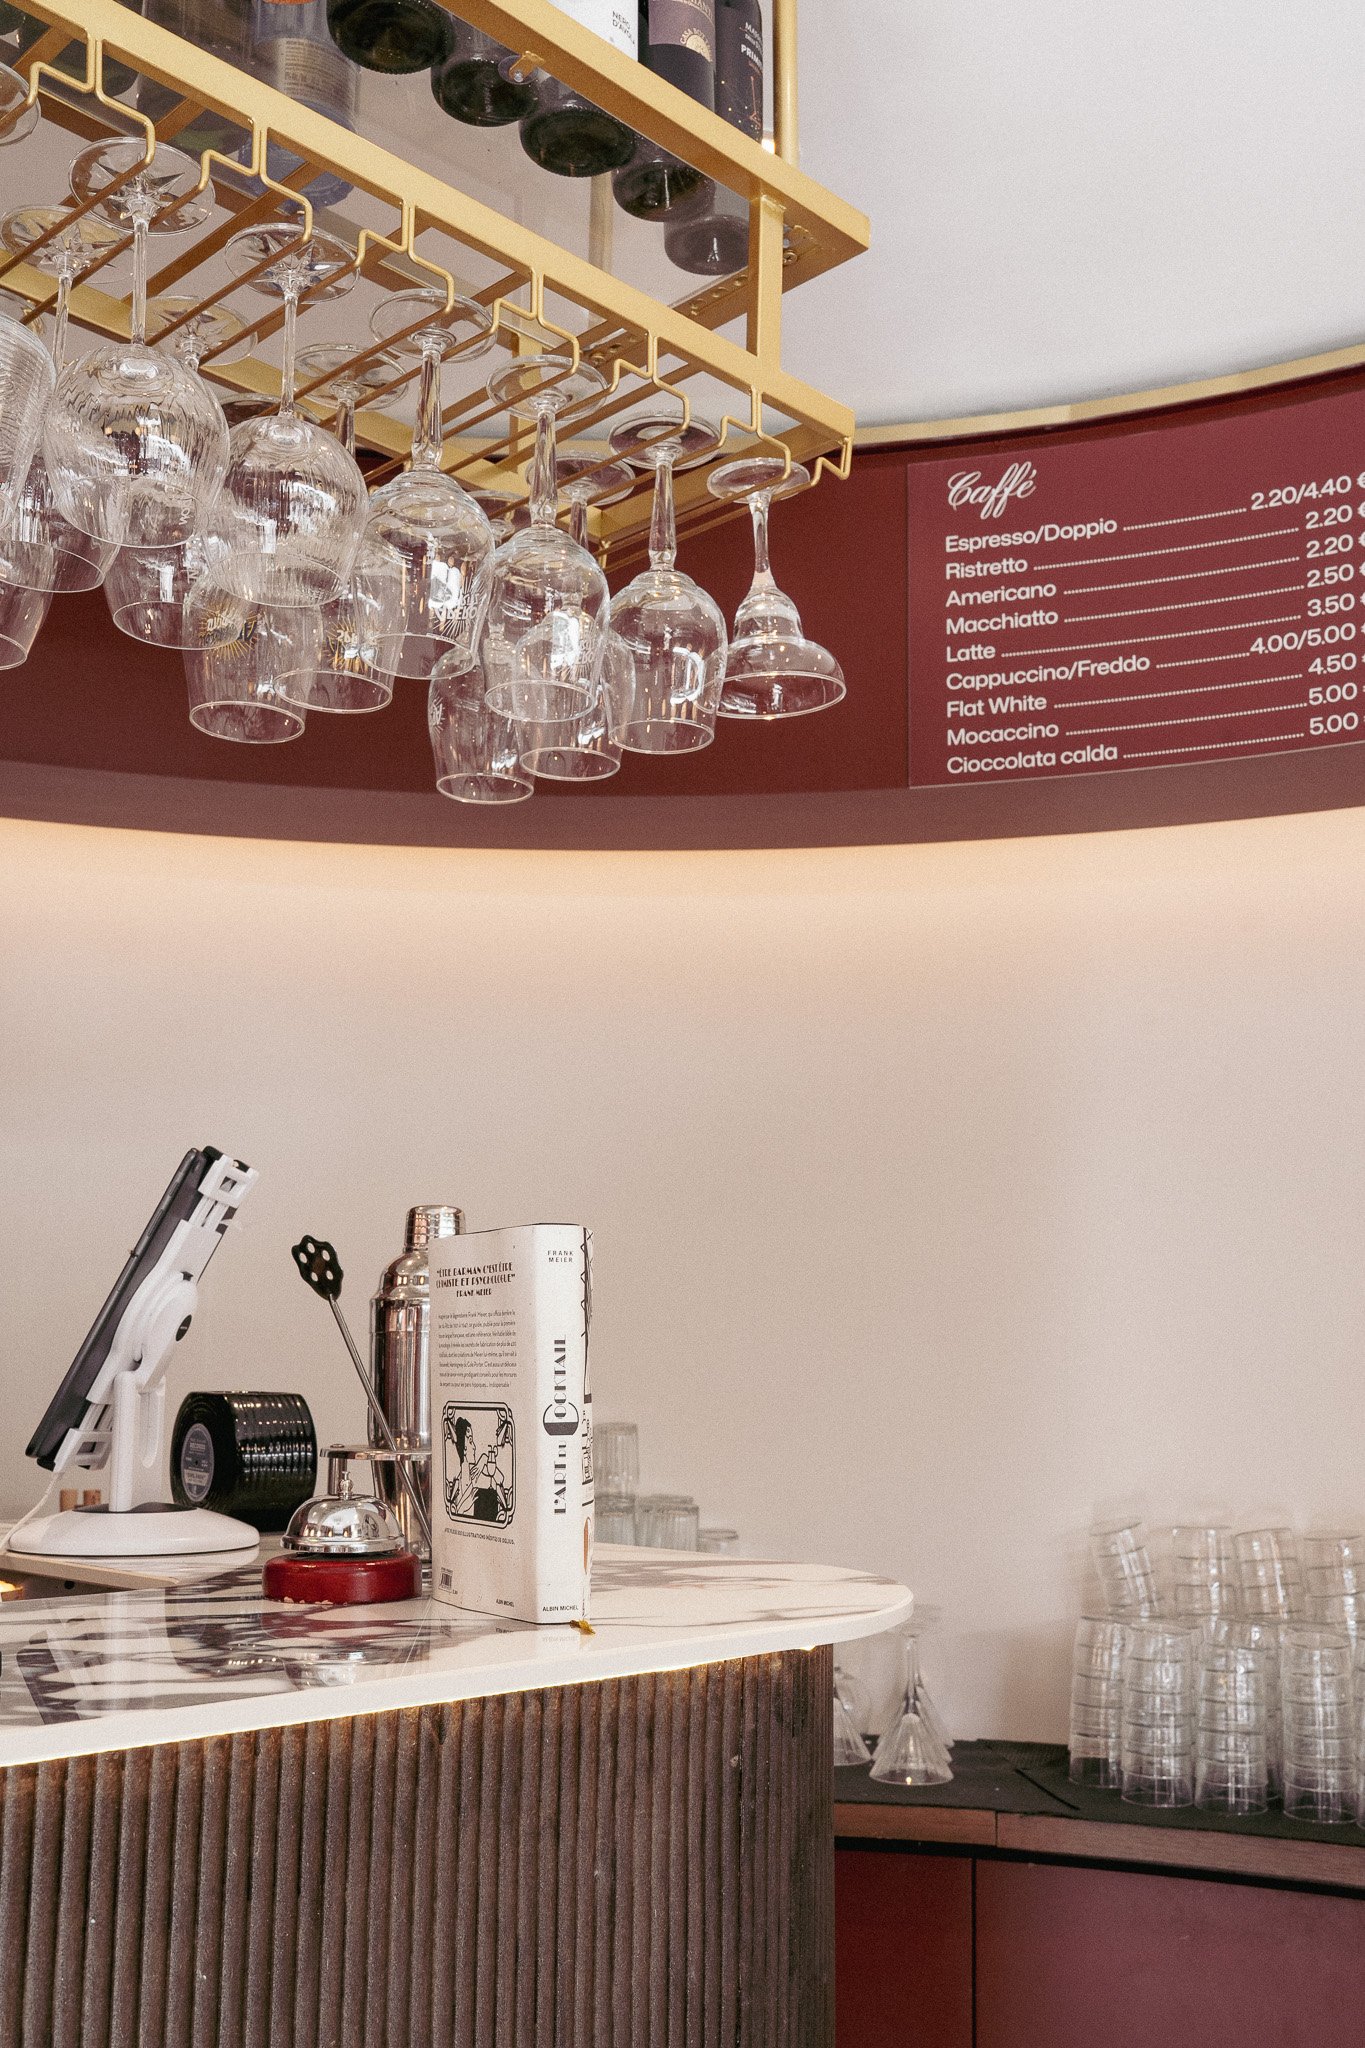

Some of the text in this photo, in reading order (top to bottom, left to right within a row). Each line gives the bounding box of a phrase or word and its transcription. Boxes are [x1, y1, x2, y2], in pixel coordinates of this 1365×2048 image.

[945, 517, 1118, 553] Espresso/Doppio
[1250, 476, 1352, 511] 2.20/4.40
[945, 557, 1028, 580] Ristretto
[1305, 504, 1353, 530] 2.20
[945, 583, 1057, 607] Americano
[1305, 533, 1354, 559] 2.20
[946, 609, 1059, 635] Macchiatto
[1306, 563, 1355, 588] 2.50
[945, 622, 1357, 691] Cappuccino/Freddo 4.00/5.00
[946, 643, 996, 663] Latte
[1307, 593, 1356, 617] 3.50
[946, 699, 985, 718] Flat
[987, 694, 1048, 715] White
[1307, 652, 1357, 676] 4.50
[947, 682, 1358, 746] Mocaccino 5.00
[946, 711, 1359, 774] Cioccolata calda 5.00
[460, 1277, 470, 1286] ET
[554, 1461, 567, 1514] L'ART
